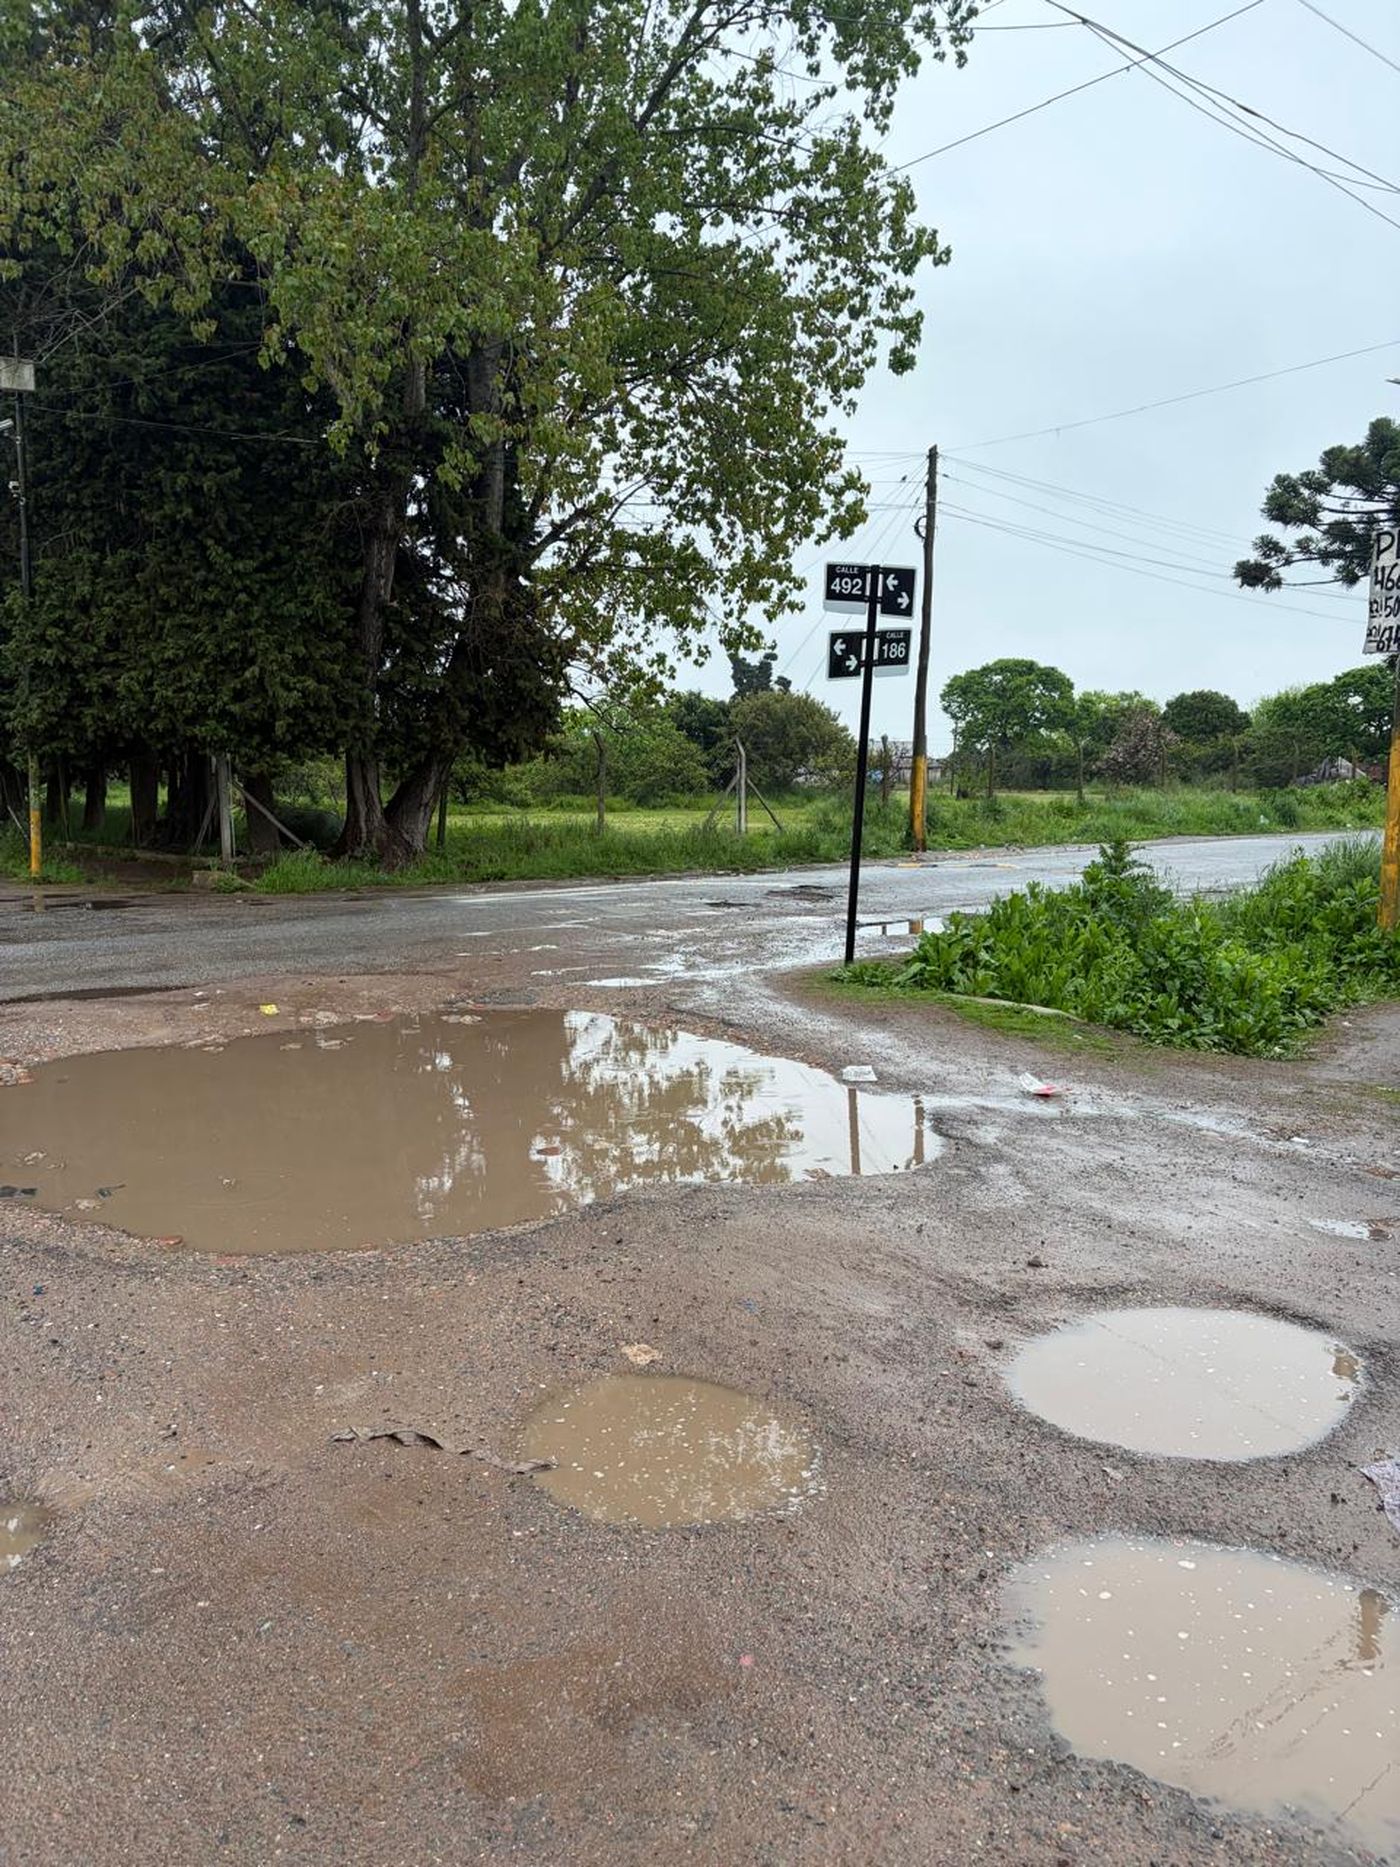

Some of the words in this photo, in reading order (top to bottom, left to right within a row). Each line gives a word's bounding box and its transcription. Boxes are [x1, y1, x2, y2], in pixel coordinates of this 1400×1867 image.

[835, 566, 859, 574] CALLE
[831, 577, 862, 595] 492
[882, 642, 906, 659] 186
